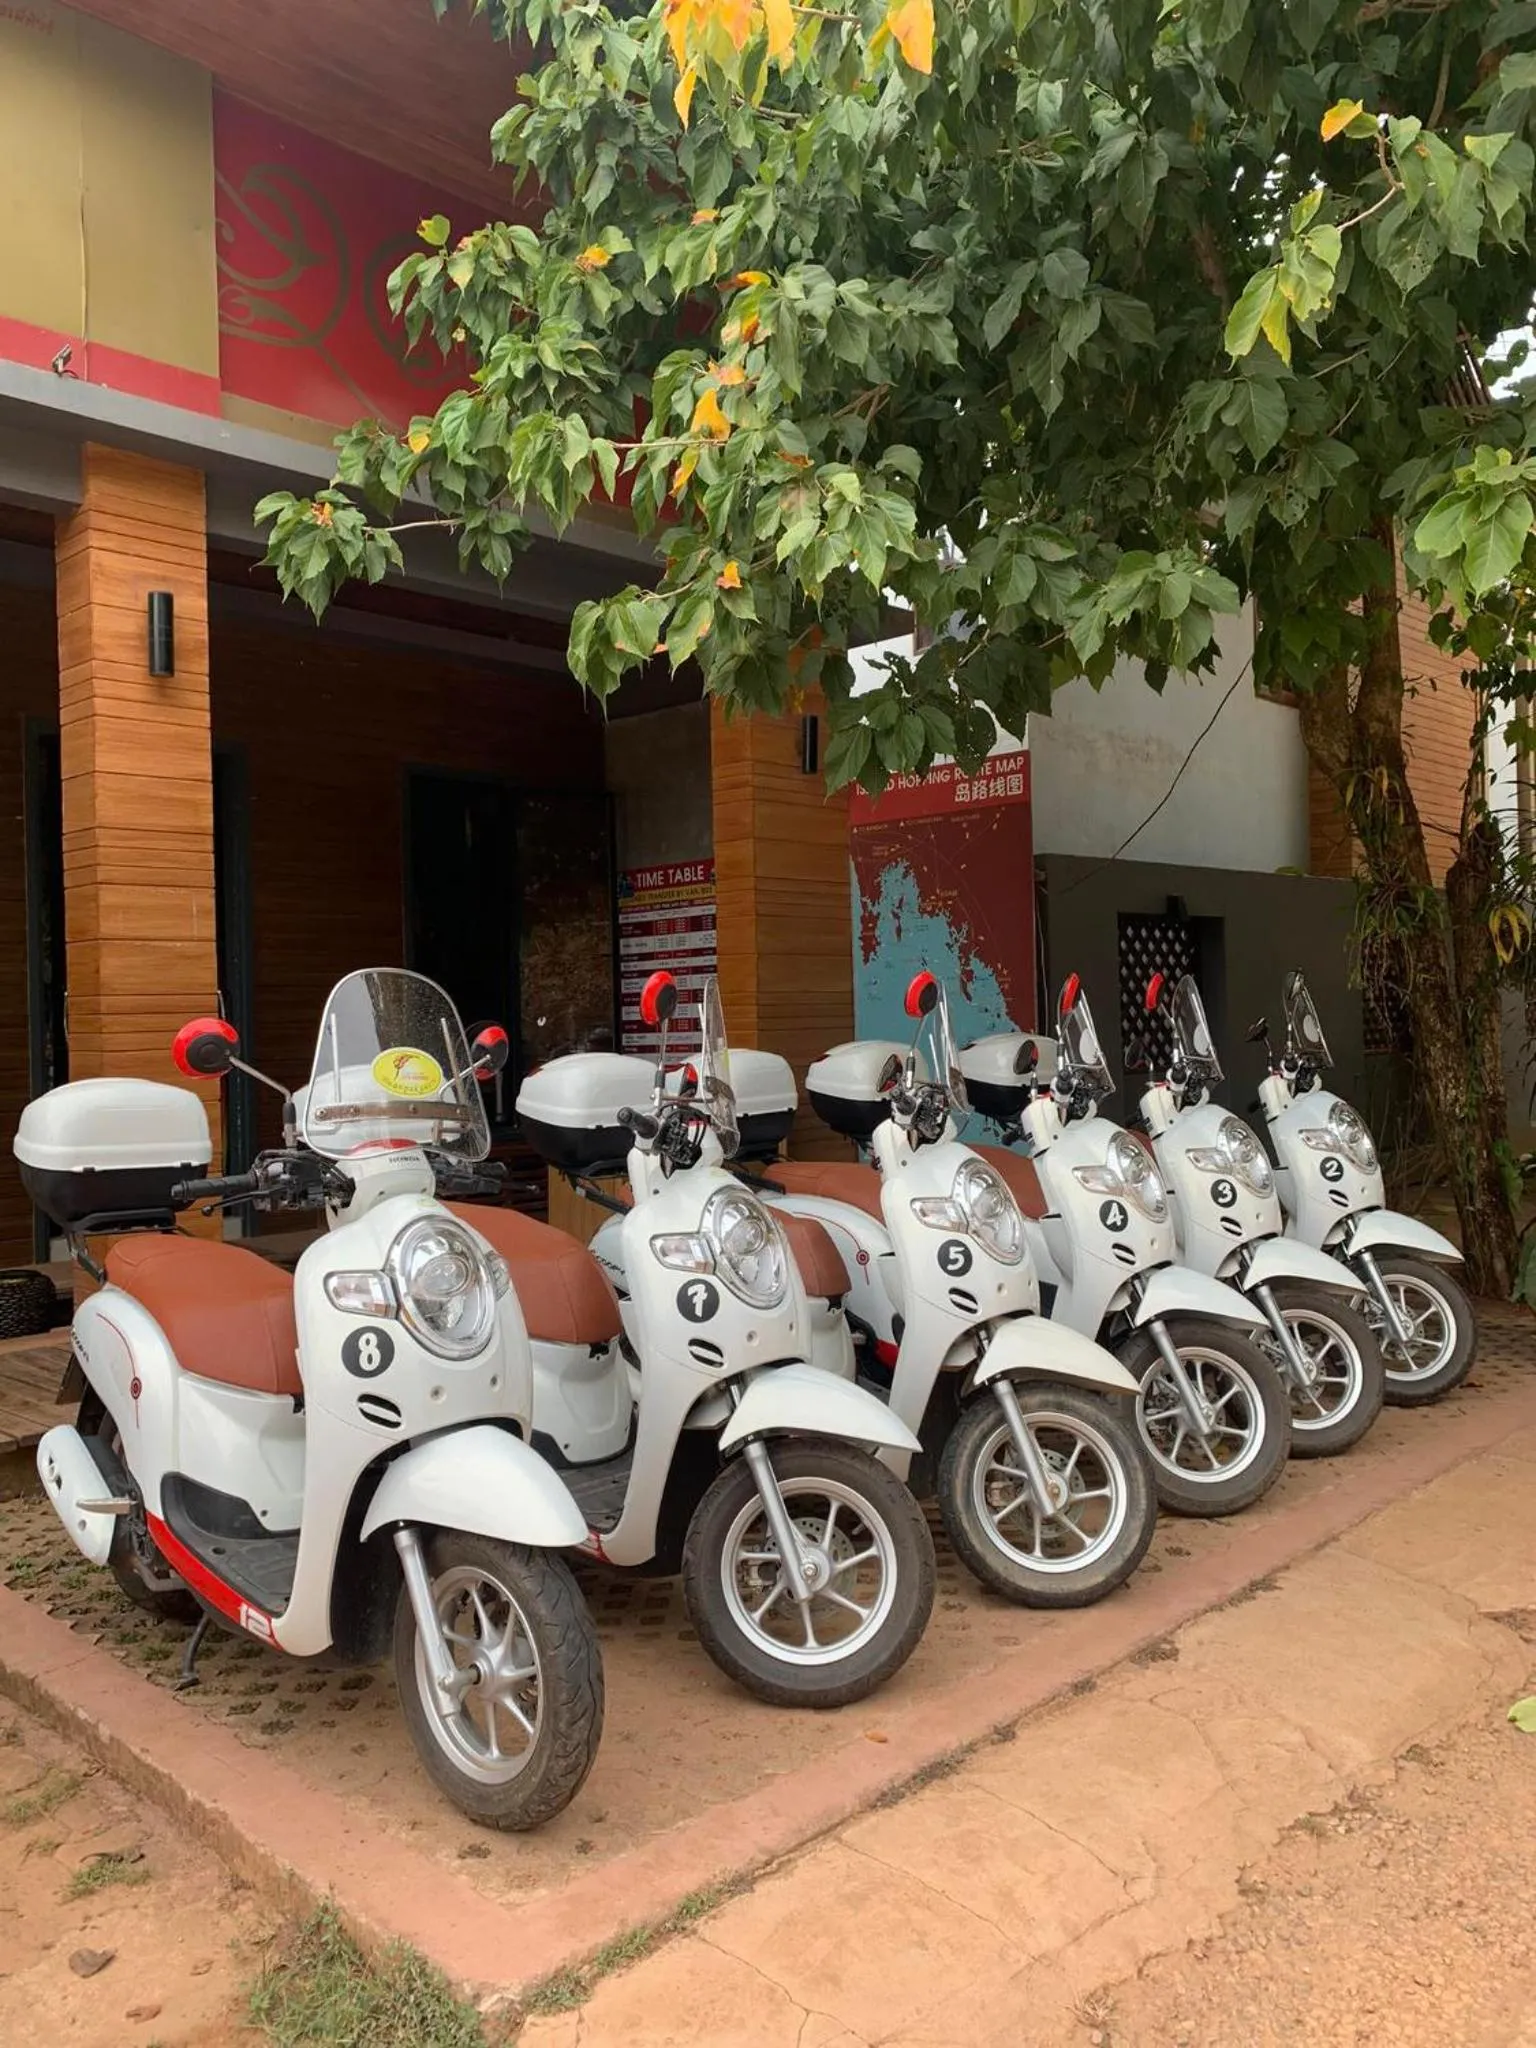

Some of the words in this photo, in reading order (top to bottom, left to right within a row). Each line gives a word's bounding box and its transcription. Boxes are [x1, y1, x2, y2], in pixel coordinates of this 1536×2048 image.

[898, 770, 951, 789] HOPING
[954, 762, 992, 779] ROTE
[996, 756, 1025, 774] MAP
[955, 773, 1023, 803] 岛路线图
[636, 870, 665, 888] TIME
[667, 865, 704, 884] TABLE
[1325, 1160, 1341, 1177] 2
[1217, 1182, 1233, 1203] 3
[1106, 1202, 1125, 1226] 4
[947, 1246, 965, 1271] 5
[687, 1284, 708, 1318] 7
[358, 1332, 382, 1371] 8
